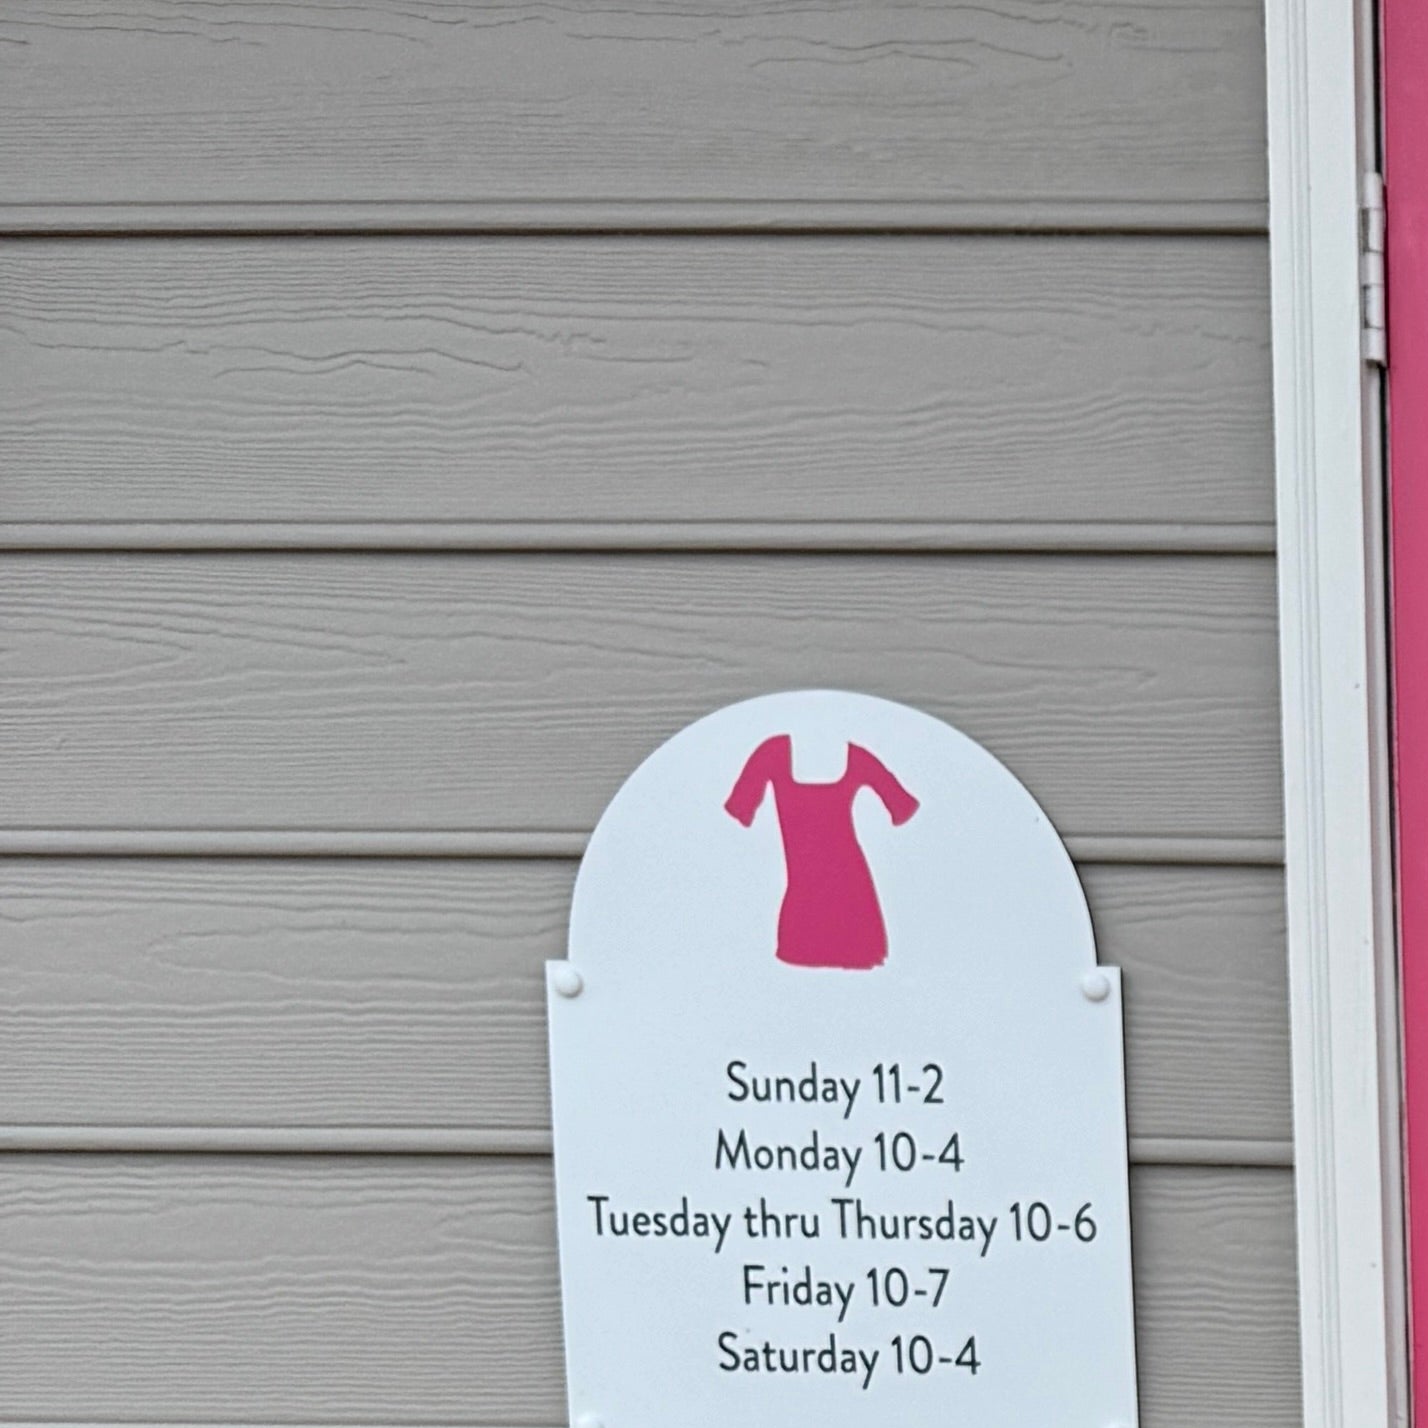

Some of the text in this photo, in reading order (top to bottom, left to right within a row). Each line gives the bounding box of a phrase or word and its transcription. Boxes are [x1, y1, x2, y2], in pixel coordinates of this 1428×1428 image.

[727, 1061, 944, 1119] Sunday 11-2
[715, 1129, 964, 1188] Monday 10-4
[587, 1196, 1096, 1257] Tuesday thru Thursday 10-6
[743, 1265, 949, 1323] Friday 10-7
[718, 1331, 981, 1390] Saturday 10-4
